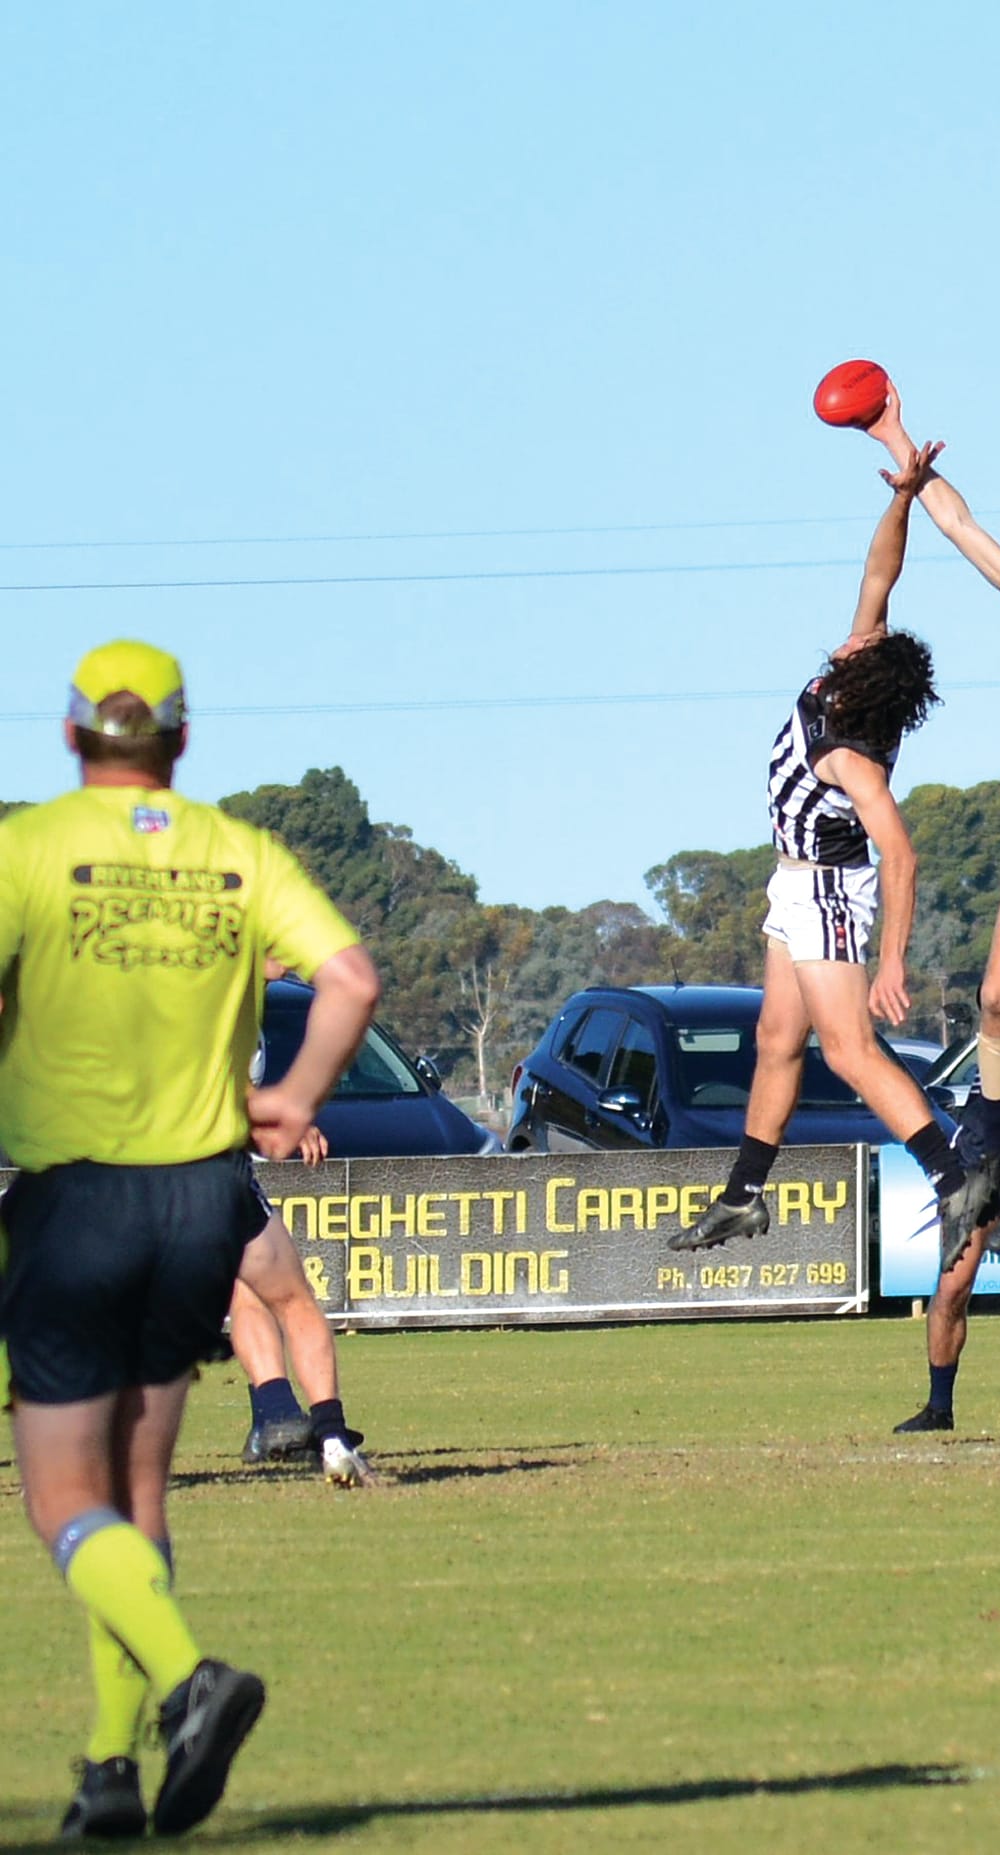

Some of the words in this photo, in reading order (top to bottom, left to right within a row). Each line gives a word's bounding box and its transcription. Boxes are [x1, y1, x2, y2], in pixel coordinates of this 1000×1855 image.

[71, 897, 243, 959] PREMIER
[545, 1177, 848, 1233] CARPERY
[303, 1256, 331, 1300] &
[657, 1267, 692, 1290] Ph.
[701, 1265, 752, 1289] 0437
[759, 1264, 799, 1287] 627
[805, 1262, 847, 1285] 699
